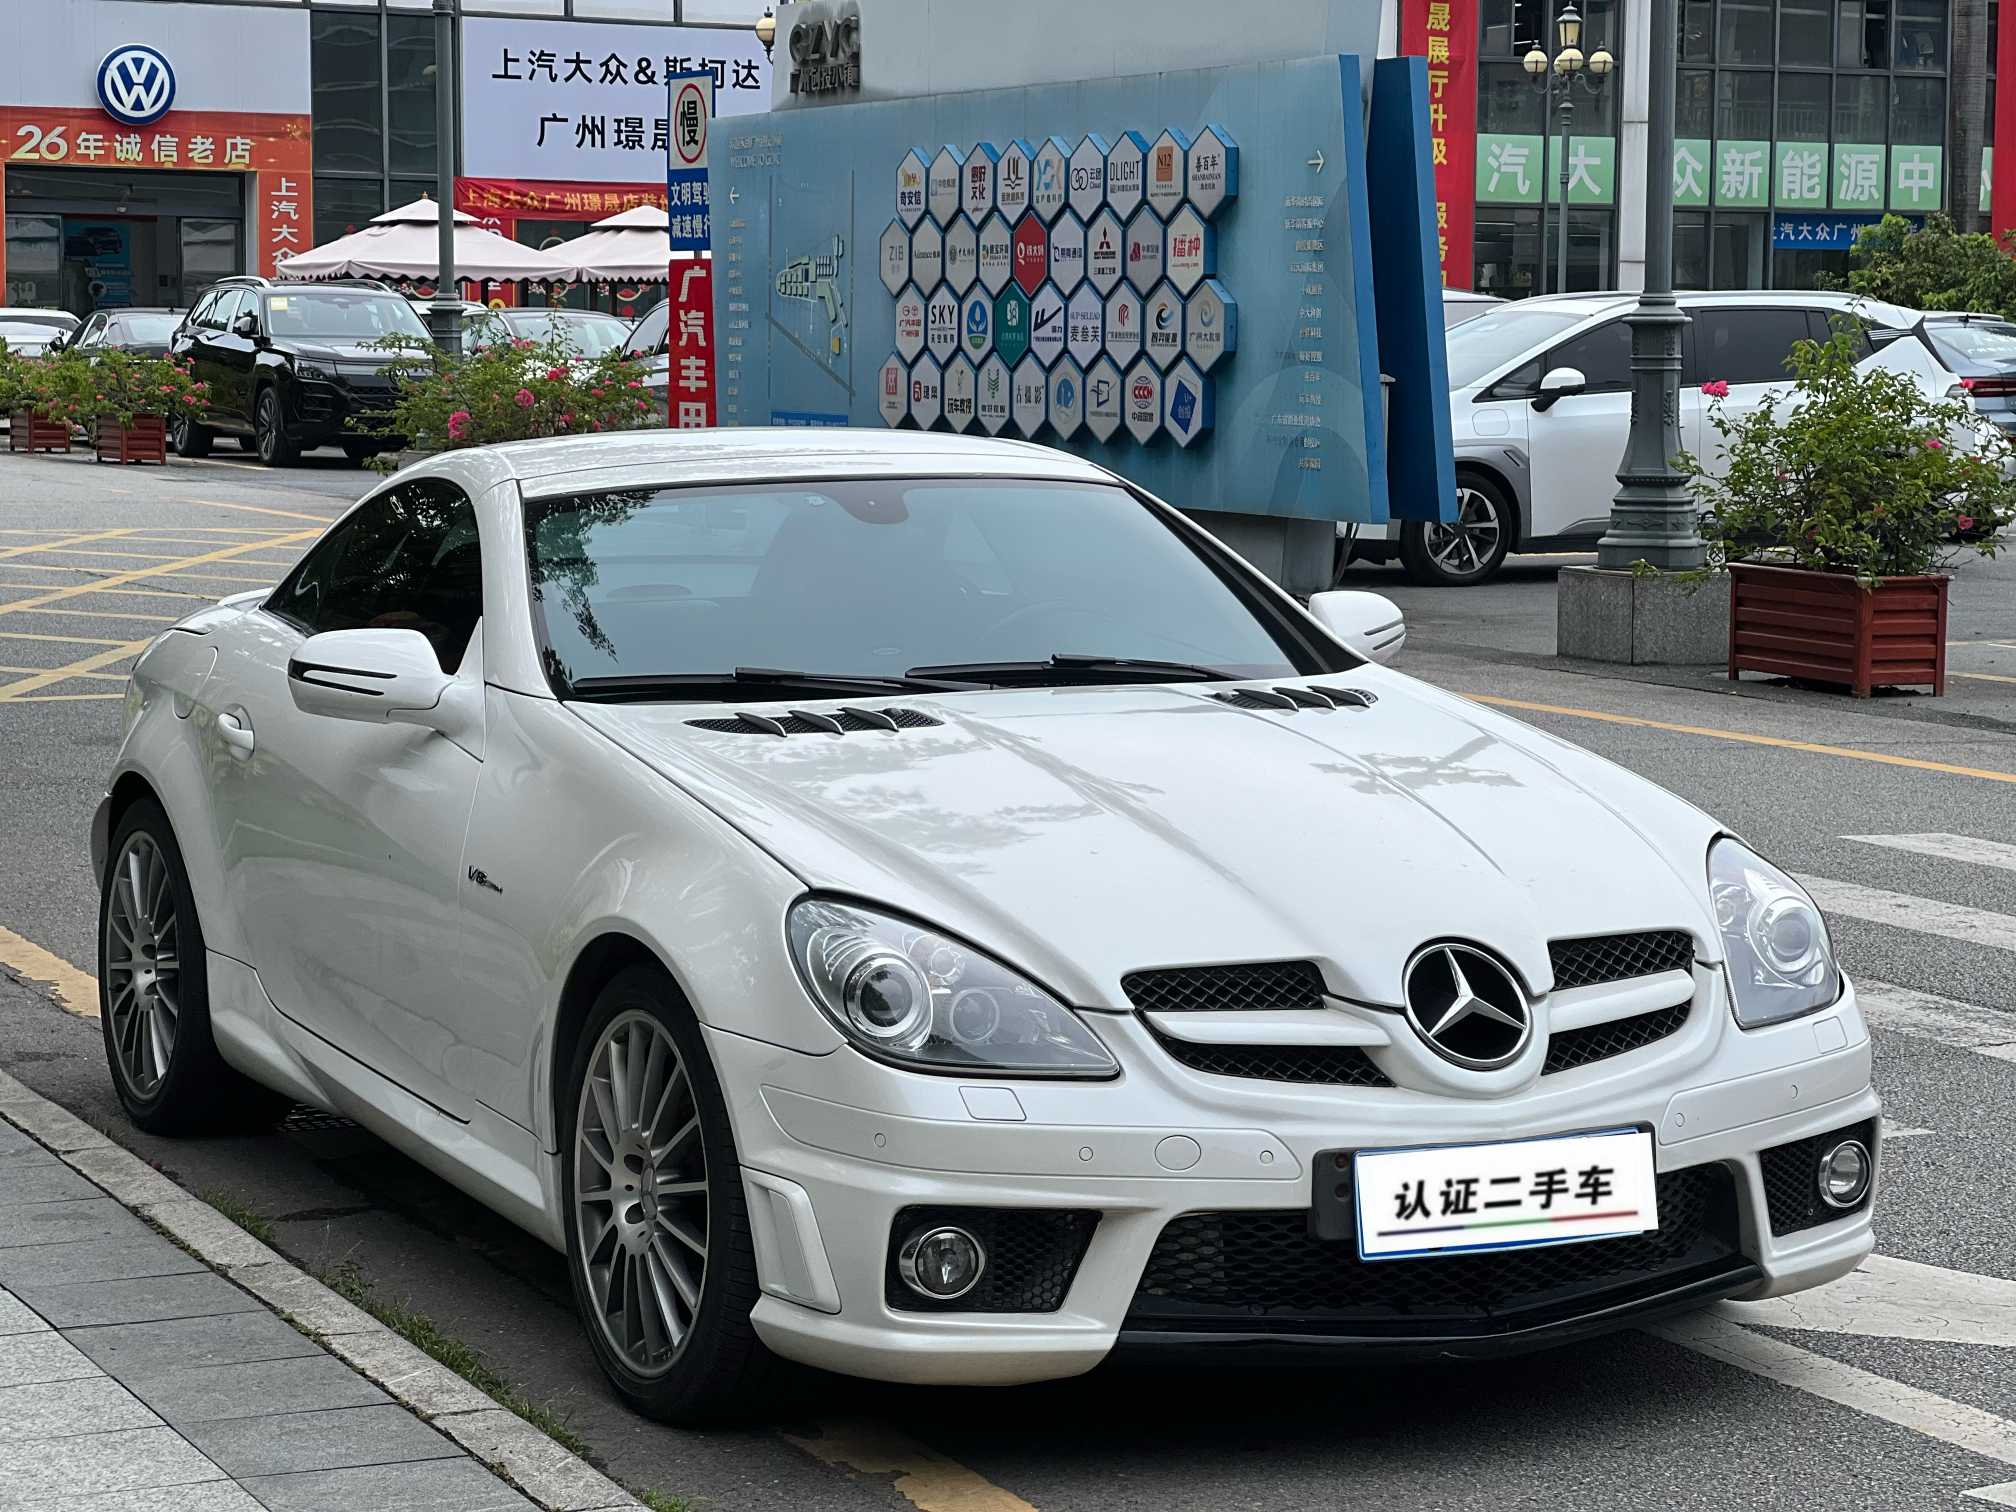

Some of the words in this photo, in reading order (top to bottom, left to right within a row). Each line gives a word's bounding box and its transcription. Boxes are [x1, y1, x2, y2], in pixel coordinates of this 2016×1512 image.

[10, 124, 252, 165] 26年诚信老店
[680, 100, 699, 147] 慢
[930, 304, 956, 325] SKY
[678, 265, 708, 427] 广汽丰田
